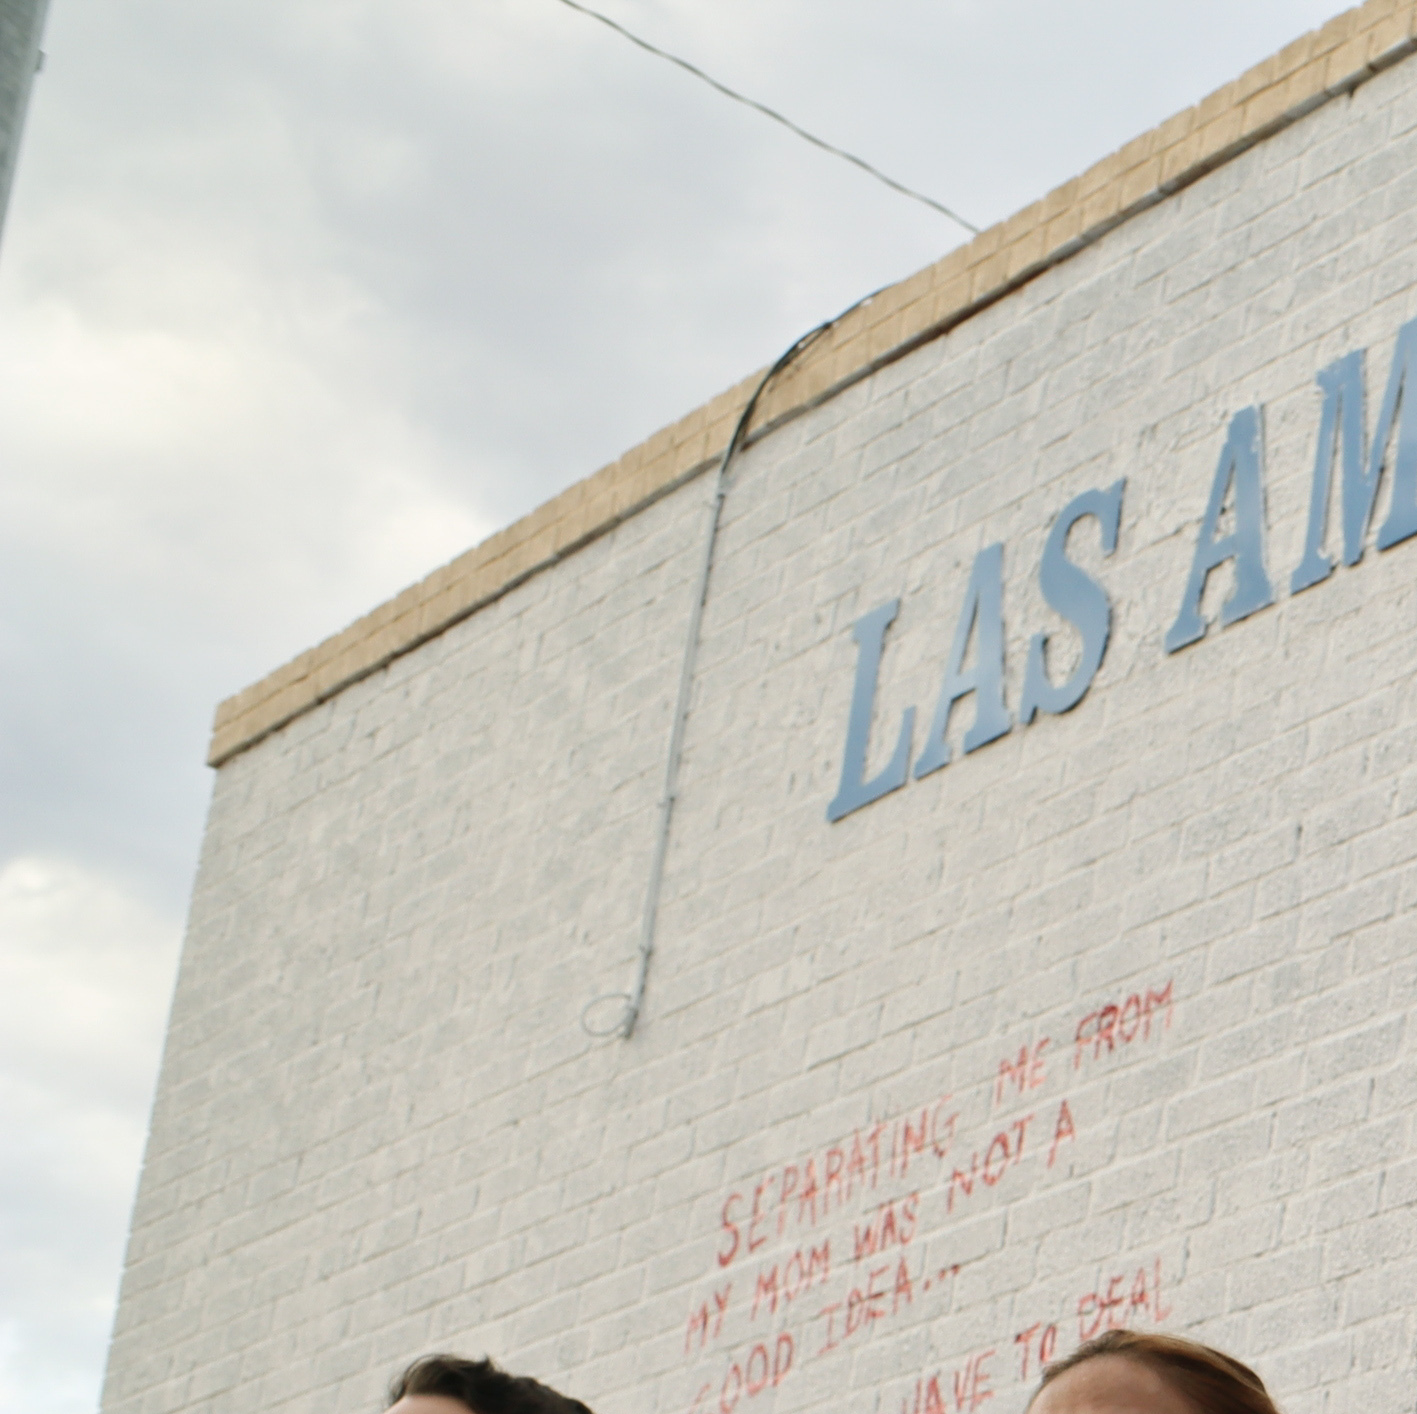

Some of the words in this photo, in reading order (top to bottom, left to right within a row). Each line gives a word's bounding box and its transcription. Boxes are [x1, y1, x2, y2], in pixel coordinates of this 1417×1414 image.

[828, 478, 1127, 822] LAS
[684, 1283, 732, 1354] MY
[750, 1240, 830, 1321] MOM
[853, 1193, 919, 1264] WAS
[946, 1113, 1035, 1213] NOT
[1047, 1098, 1077, 1169] A
[717, 1094, 960, 1268] SEPARATING
[999, 1037, 1052, 1104] ME
[1074, 981, 1174, 1071] FROM
[1013, 1322, 1057, 1380] TO
[1078, 1257, 1173, 1341] DEAL
